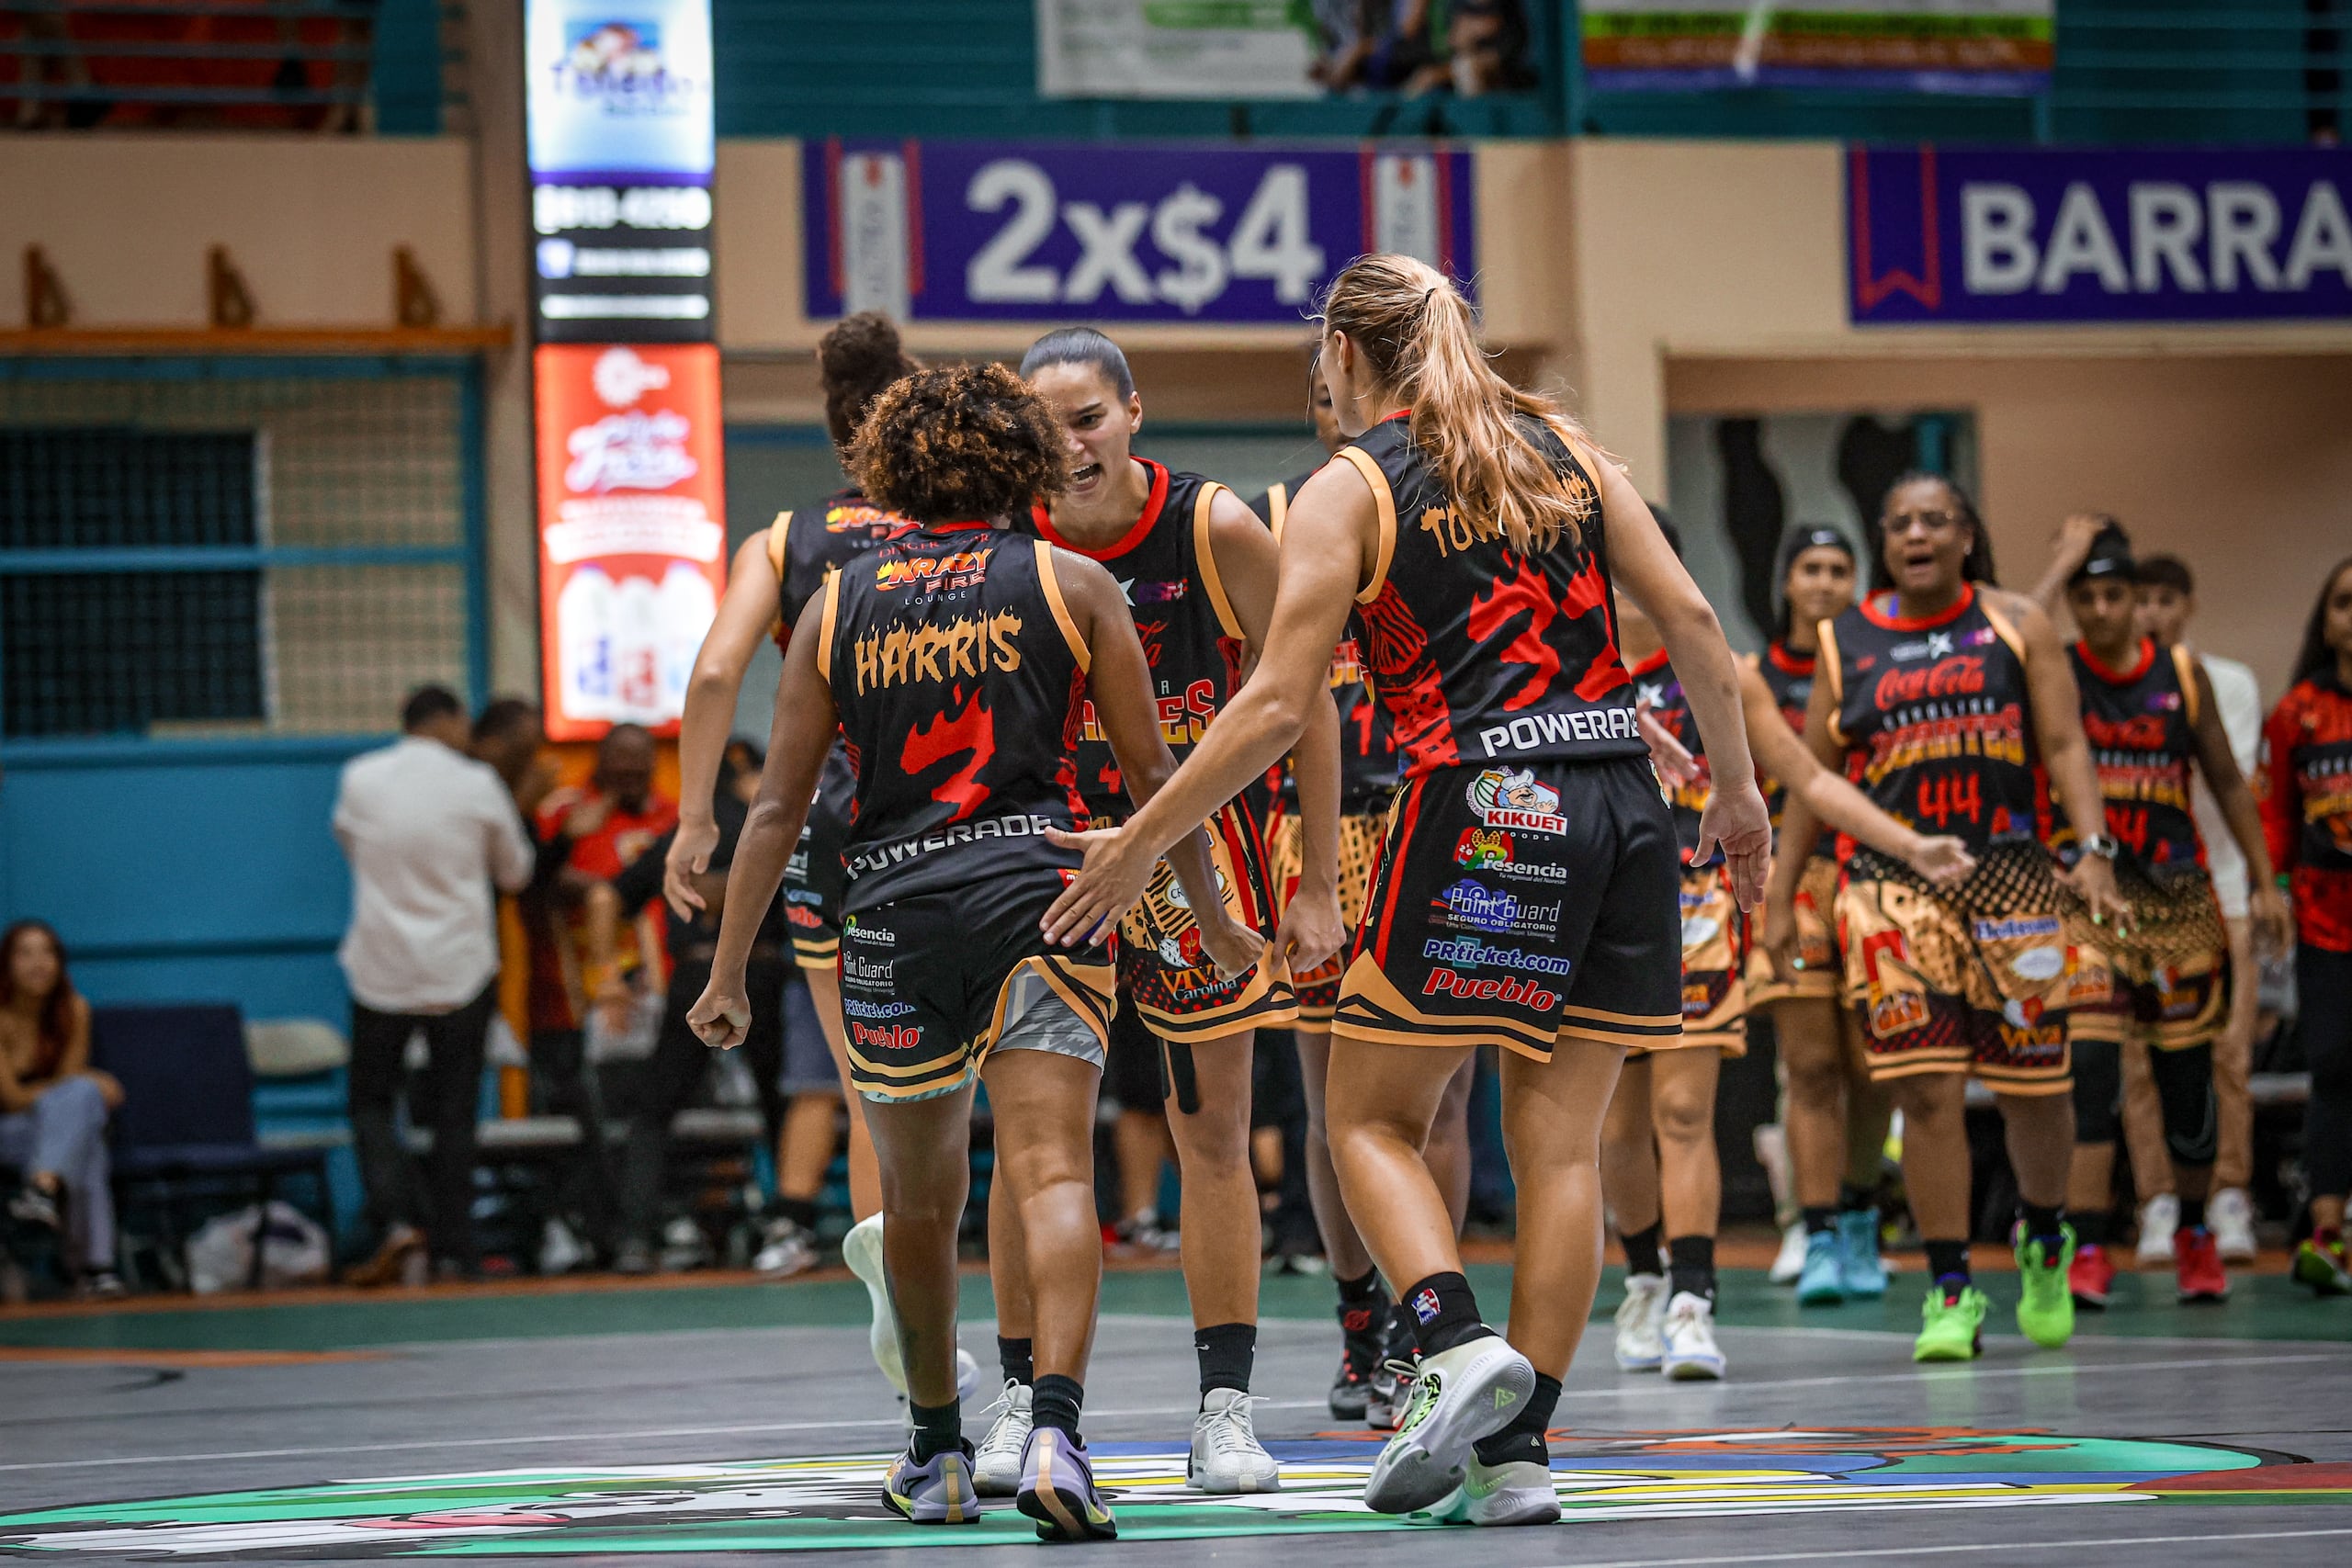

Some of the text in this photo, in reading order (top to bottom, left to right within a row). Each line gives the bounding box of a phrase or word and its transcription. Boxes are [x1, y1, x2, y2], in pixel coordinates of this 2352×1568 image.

[966, 160, 1325, 313] 2x$4
[1961, 182, 2352, 294] BARRA
[888, 547, 994, 585] KRAZY
[924, 570, 987, 594] FIRE
[904, 591, 967, 606] LOUNGE
[854, 604, 1023, 698] HARRIS
[899, 682, 996, 824] 7
[1917, 770, 1983, 829] 44
[1487, 811, 1566, 831] KIKUET
[1464, 844, 1567, 879] Presencia
[1449, 886, 1562, 922] Point Guard
[1447, 913, 1556, 932] SEGURO OBLIGATORIO
[858, 955, 894, 979] Guard
[1423, 938, 1570, 975] PRticket.com
[1159, 964, 1220, 994] VIV
[1422, 967, 1555, 1011] Pueblo
[852, 1021, 920, 1050] Pueblo
